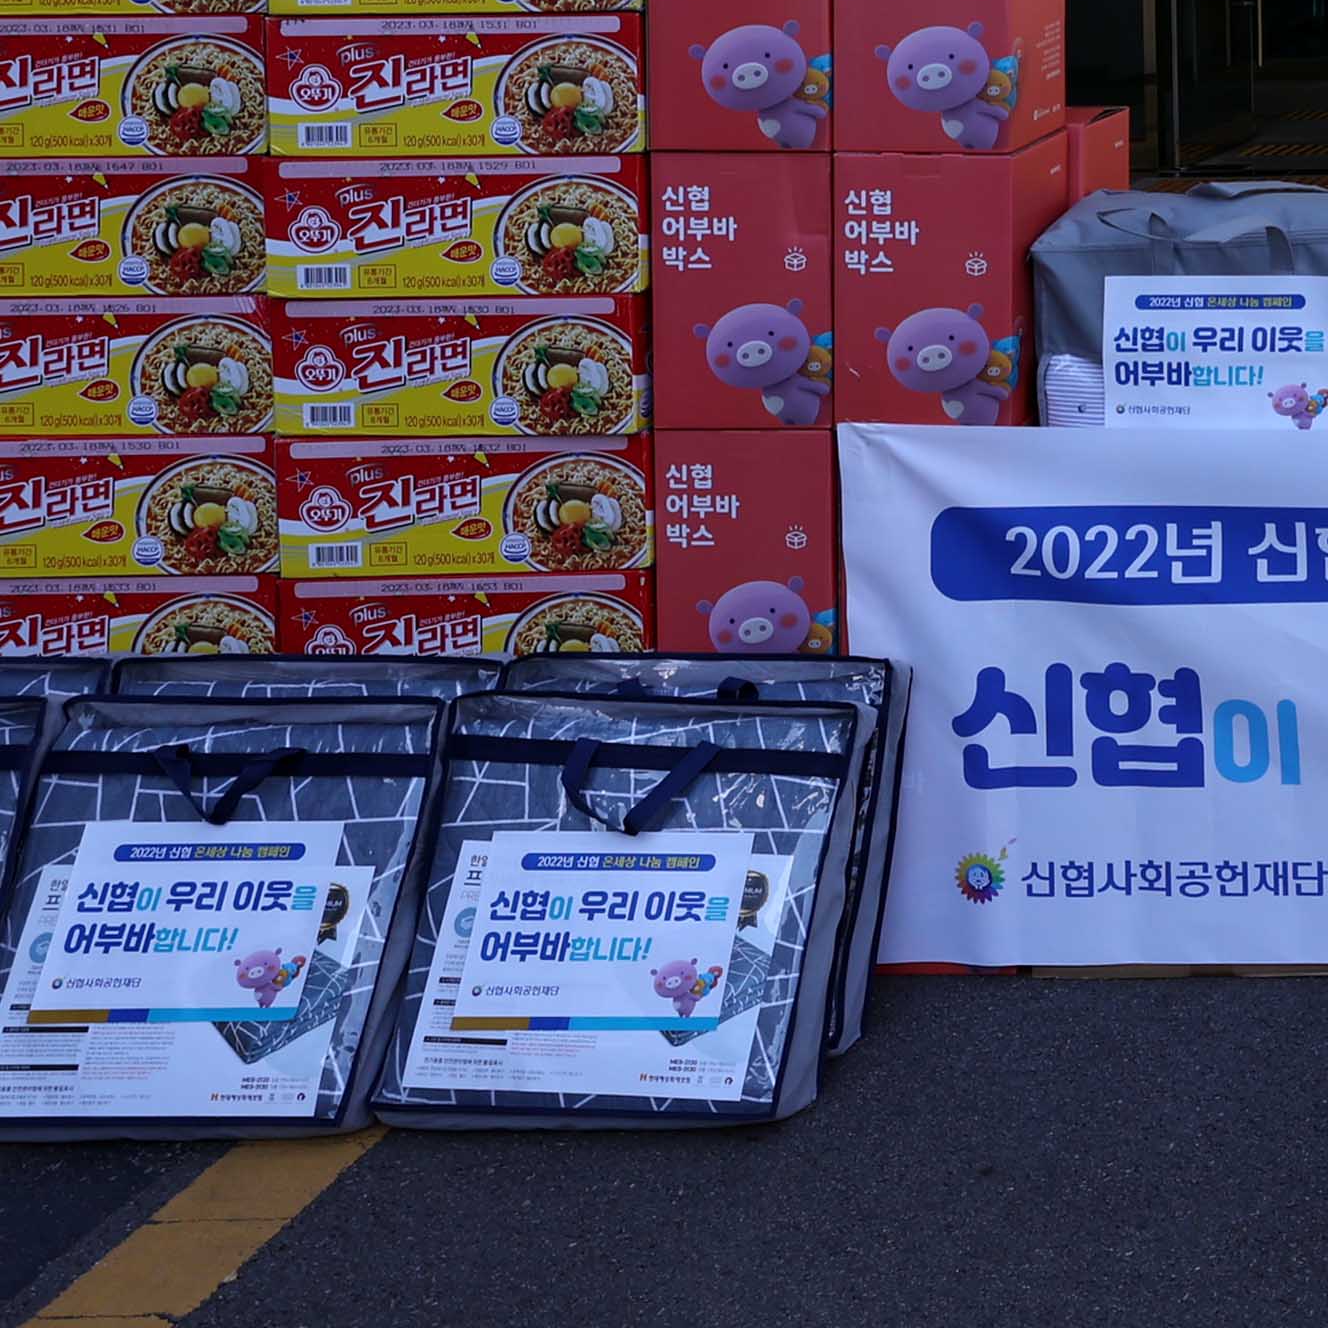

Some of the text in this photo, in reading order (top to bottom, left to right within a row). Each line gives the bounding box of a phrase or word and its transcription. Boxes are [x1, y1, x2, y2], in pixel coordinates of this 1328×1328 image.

[349, 57, 473, 113] 진라면
[661, 185, 710, 211] 신협
[844, 190, 892, 215] 신협
[661, 216, 737, 241] 어부바
[844, 220, 919, 245] 어부바
[662, 246, 712, 271] 박스
[845, 249, 894, 275] 박스
[1113, 326, 1325, 353] 신협이 우리 이웃을
[351, 337, 472, 392] 진라면
[1114, 360, 1264, 387] 어부바합니다!
[665, 464, 713, 490] 신협
[307, 504, 344, 522] 오뚜기
[358, 477, 479, 532] 진라면
[665, 494, 740, 520] 어부바
[666, 523, 715, 549] 박스
[1006, 520, 1224, 586] 2022년
[951, 662, 1302, 790] 신협이
[1021, 858, 1328, 900] 신협사회공헌재단
[77, 880, 317, 914] 신협이 우리 이웃을
[489, 890, 730, 922] 신협이 우리 이웃을
[64, 922, 239, 954] 어부바합니다!
[480, 931, 653, 962] 어부바합니다!
